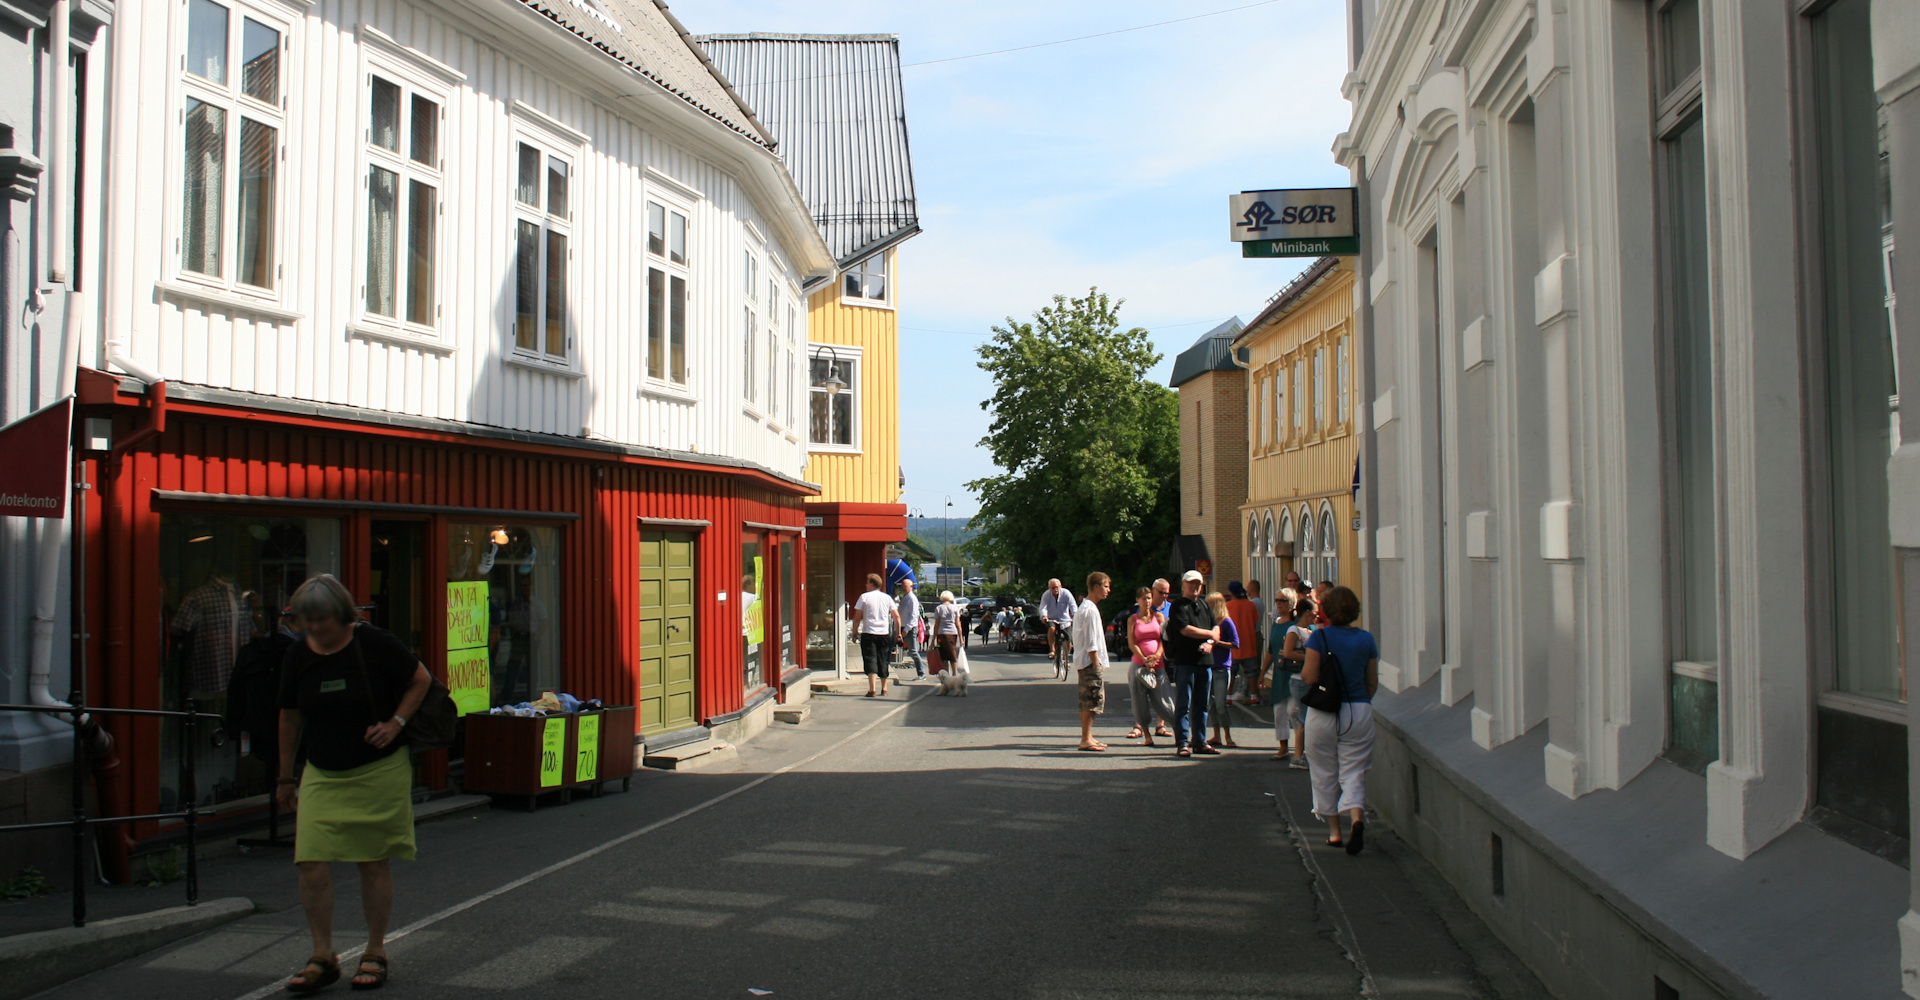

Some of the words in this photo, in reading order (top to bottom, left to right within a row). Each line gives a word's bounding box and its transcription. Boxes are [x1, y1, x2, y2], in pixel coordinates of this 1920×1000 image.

[1281, 204, 1336, 225] SØR
[1271, 240, 1330, 254] Minibank
[0, 493, 57, 508] Motekonto
